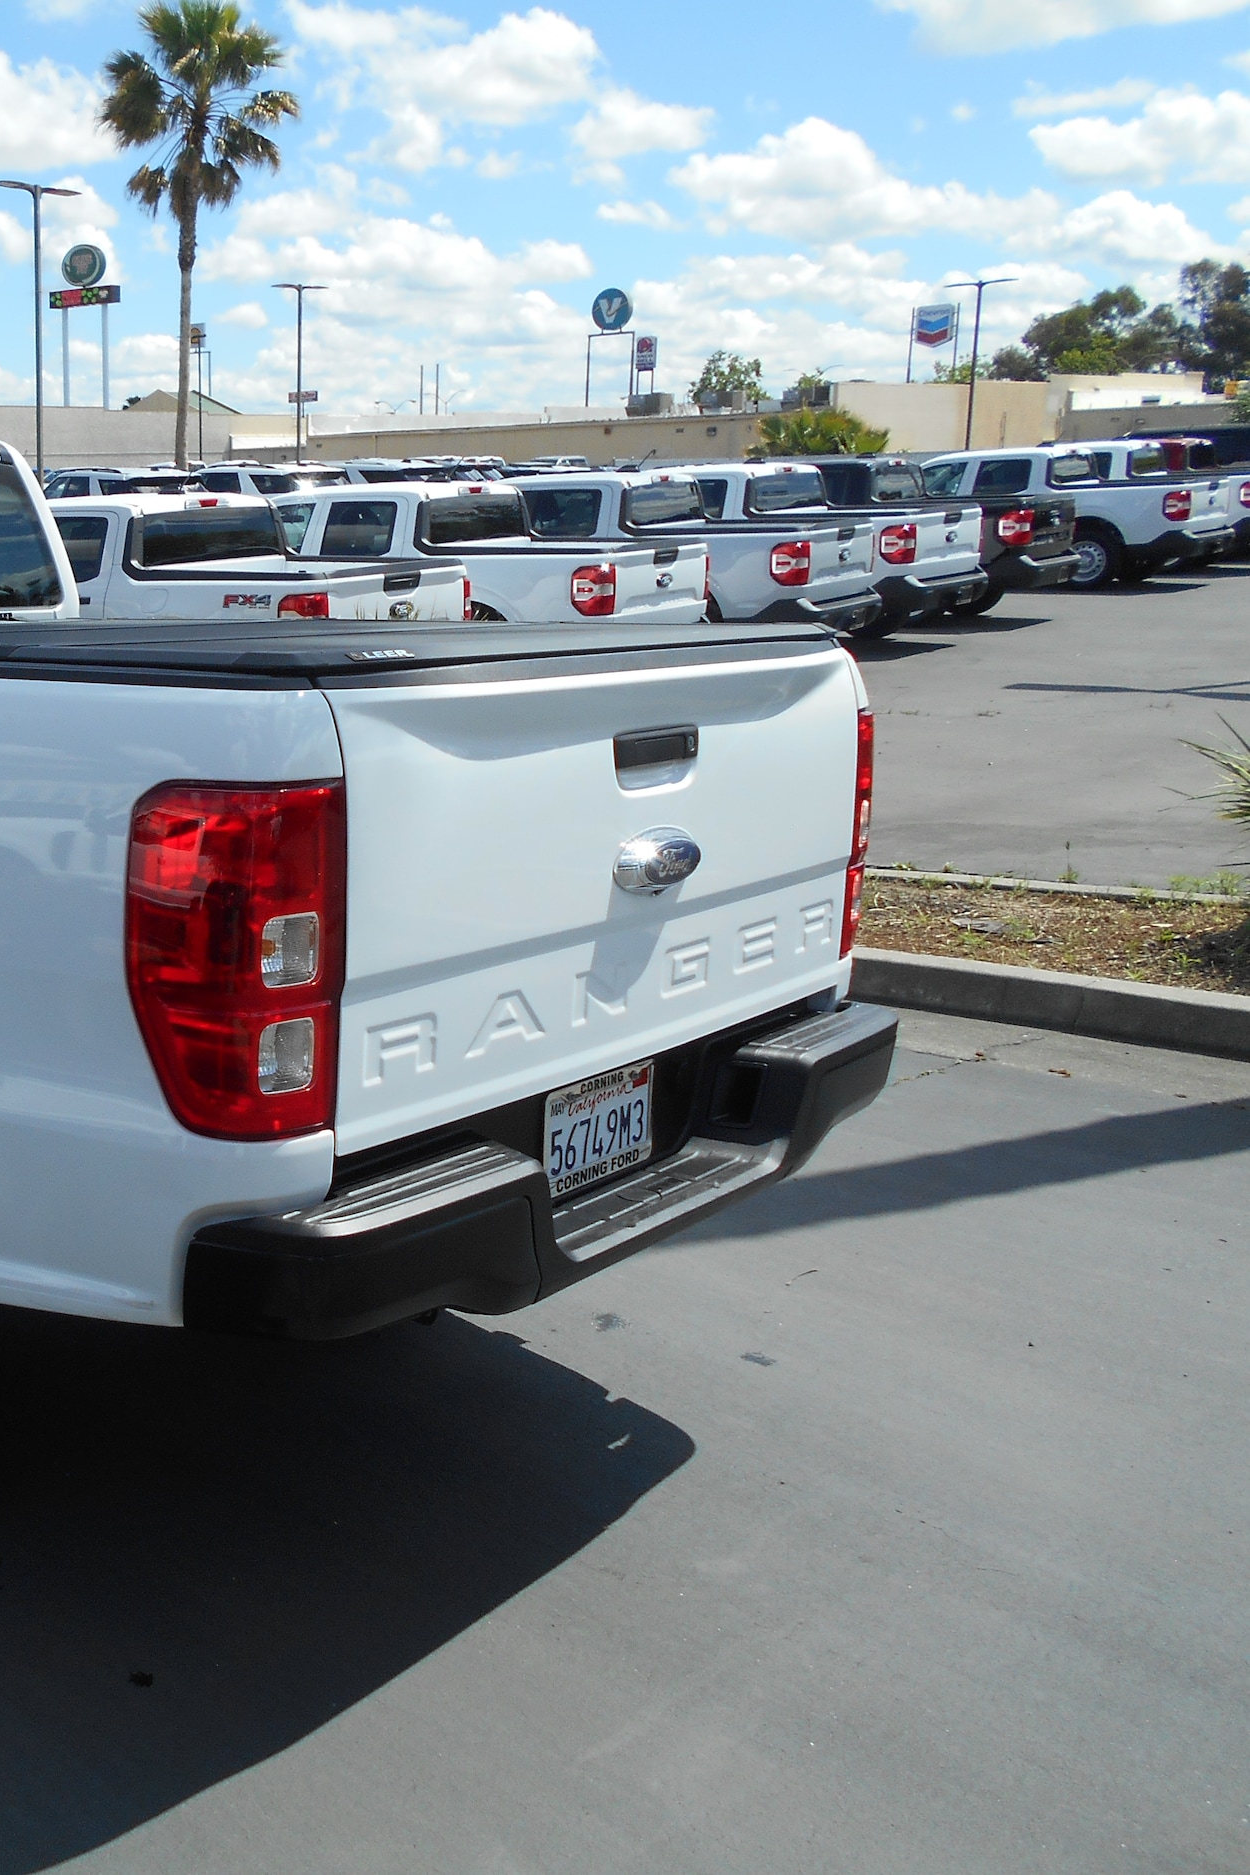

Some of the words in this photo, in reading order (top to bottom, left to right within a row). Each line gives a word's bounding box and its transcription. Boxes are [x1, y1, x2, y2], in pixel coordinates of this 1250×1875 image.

[222, 594, 271, 608] FX4
[362, 649, 415, 659] LEER
[658, 846, 690, 878] Ford
[362, 898, 835, 1089] RANGER
[580, 1071, 624, 1095] CORNING
[550, 1100, 566, 1118] MAY
[568, 1083, 634, 1117] California
[550, 1099, 644, 1176] 56749M3
[556, 1160, 608, 1193] CORNING
[611, 1148, 640, 1171] FORD
